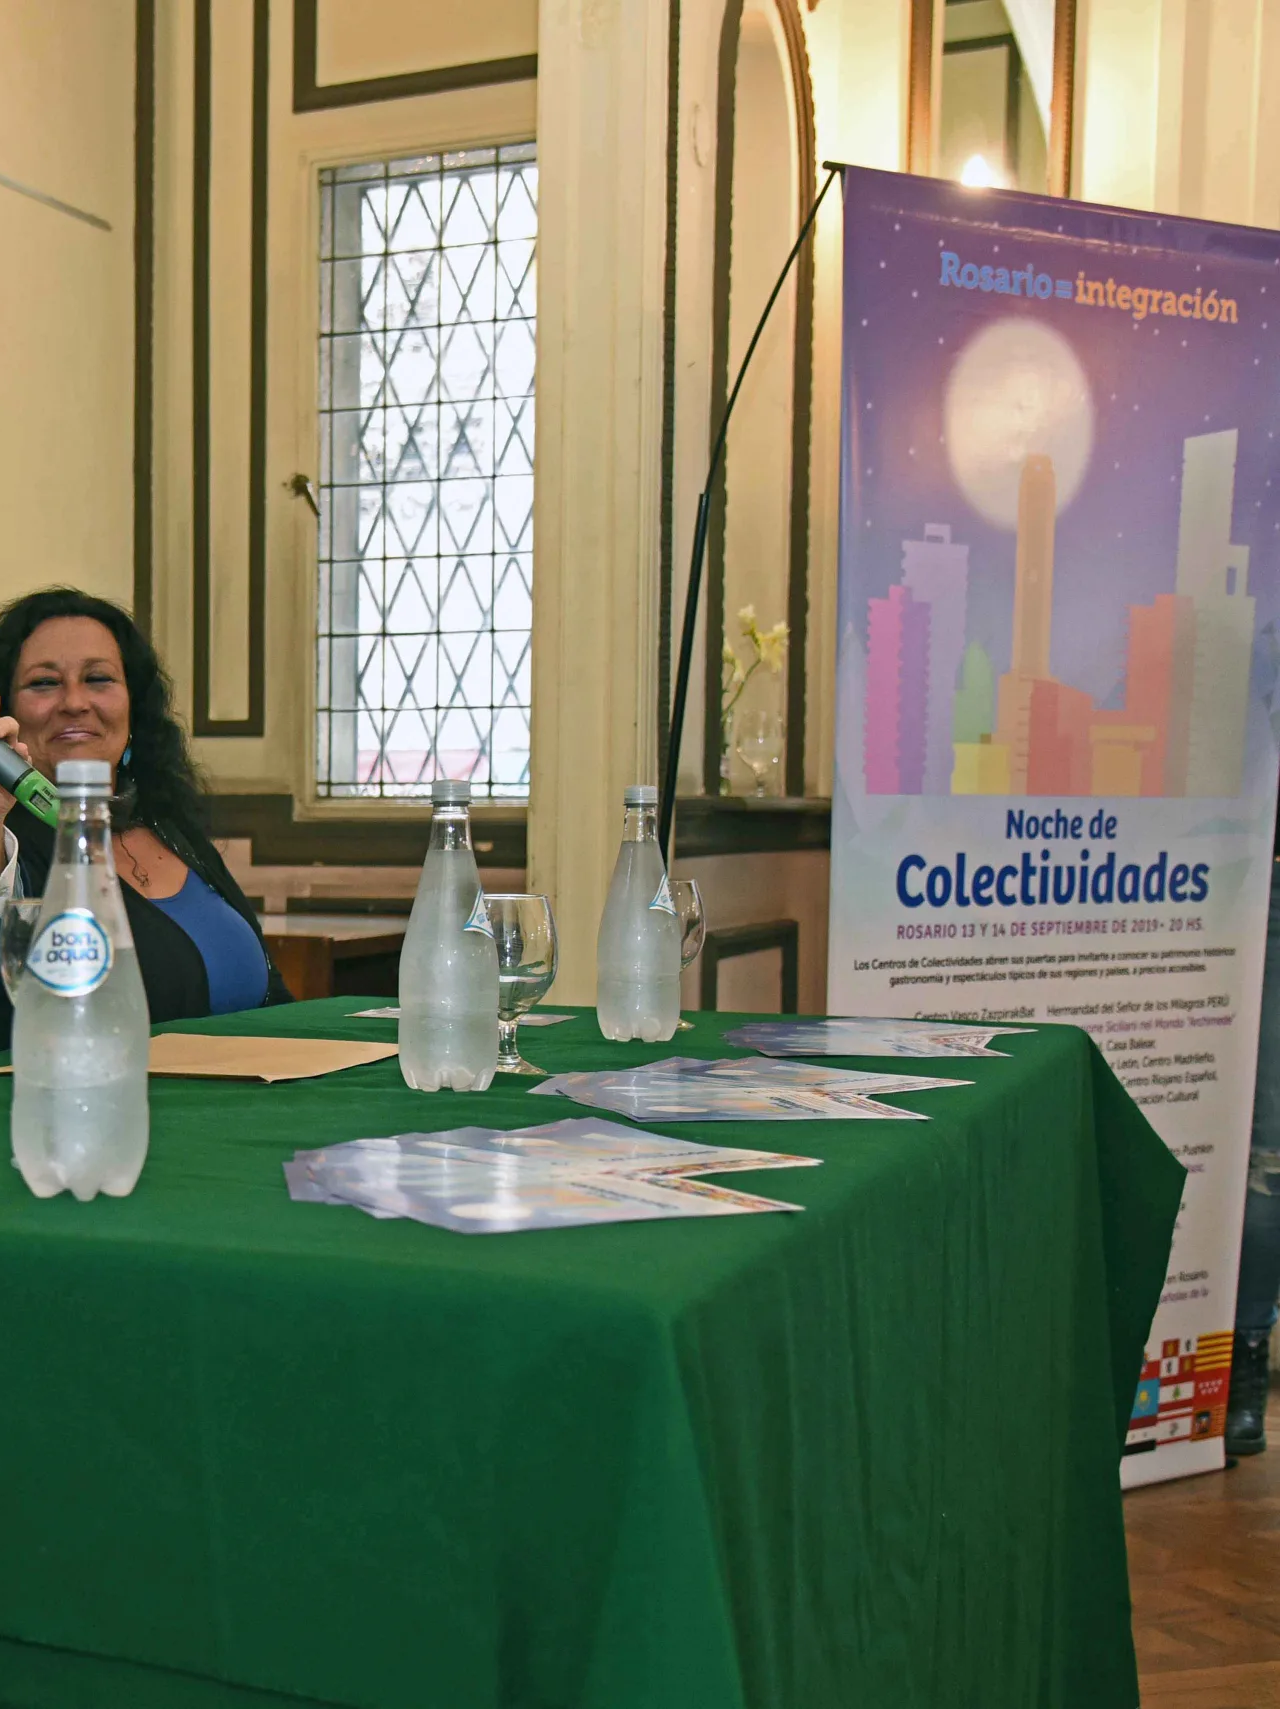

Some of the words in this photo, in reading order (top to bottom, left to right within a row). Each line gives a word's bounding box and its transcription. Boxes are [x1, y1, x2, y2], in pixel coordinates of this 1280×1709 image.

[1006, 809, 1083, 840] Noche
[1089, 809, 1118, 839] de
[896, 849, 1210, 909] Colectividades
[897, 923, 957, 940] ROSARIO
[962, 923, 976, 938] 13
[980, 922, 989, 938] Y
[992, 922, 1007, 938] 14
[1011, 922, 1027, 937] DE
[1031, 919, 1109, 936] SEPTIEMBRE
[1112, 919, 1128, 934] DE
[1169, 918, 1185, 932] 20
[46, 948, 99, 966] aqua
[854, 959, 870, 971] Los
[871, 958, 907, 970] Centros
[908, 957, 919, 969] de
[921, 955, 983, 968] Colectividades
[985, 955, 1009, 966] abren
[1011, 956, 1024, 965] sus
[1025, 953, 1056, 966] puertas
[1058, 954, 1076, 965] para
[1078, 951, 1110, 963] invitarte
[889, 975, 943, 988] gastronomía
[945, 975, 950, 985] y
[952, 971, 1007, 984] espectáculos
[1008, 970, 1035, 983] típicos
[1037, 969, 1048, 980] de
[1050, 969, 1062, 979] sus
[1064, 967, 1098, 981] regiones
[1098, 968, 1104, 979] y
[1132, 966, 1138, 975] a
[1139, 964, 1167, 977] precios
[1047, 1003, 1099, 1017] Hermandad
[1101, 1002, 1114, 1014] del
[1116, 1000, 1142, 1013] Señor
[1143, 1000, 1154, 1011] de
[1156, 999, 1168, 1011] los
[1170, 997, 1205, 1012] Milagros
[1106, 1039, 1127, 1051] Casa
[1142, 1055, 1171, 1068] Centro
